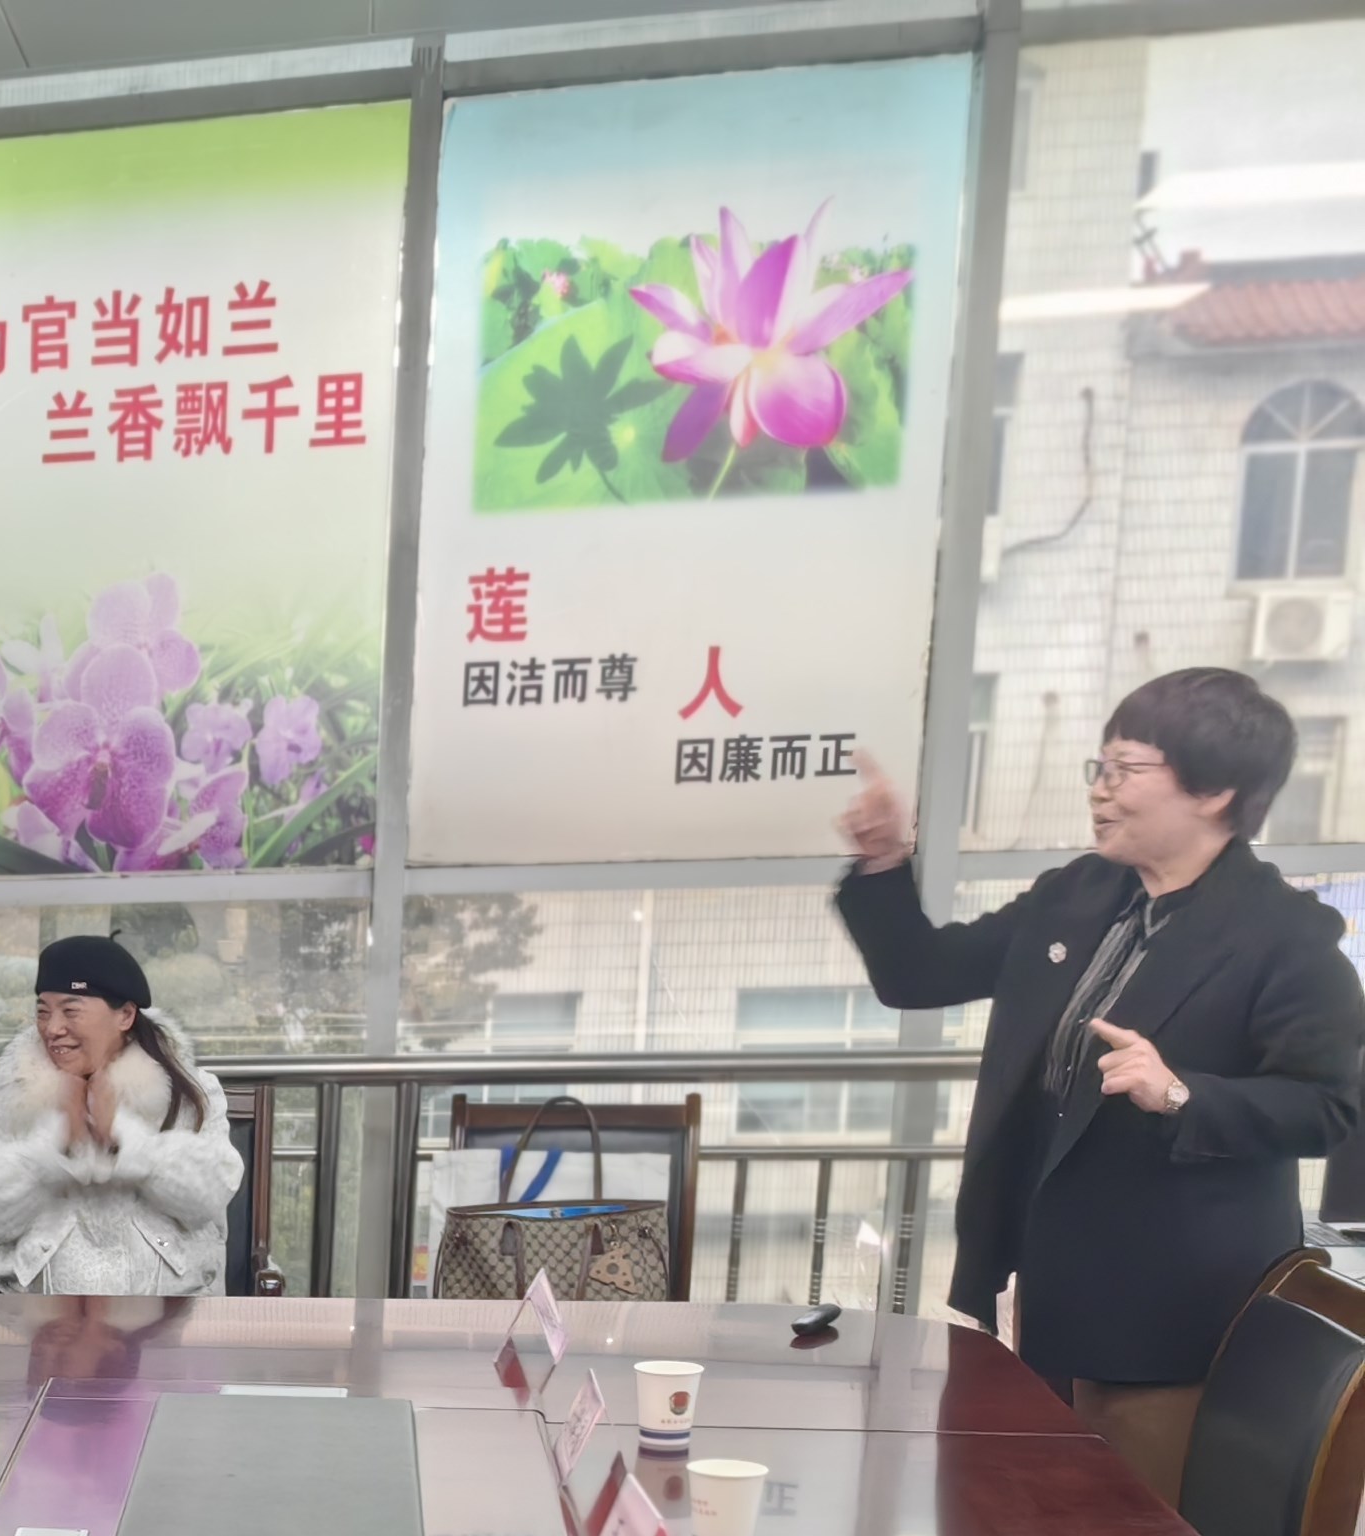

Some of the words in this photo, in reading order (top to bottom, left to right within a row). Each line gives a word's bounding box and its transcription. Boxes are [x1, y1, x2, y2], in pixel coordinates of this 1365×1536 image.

[42, 373, 366, 464] 兰香飘千里
[466, 567, 530, 643] 莲
[462, 653, 638, 707] 因洁而尊
[678, 646, 743, 720] 人
[674, 733, 857, 784] 因廉而正
